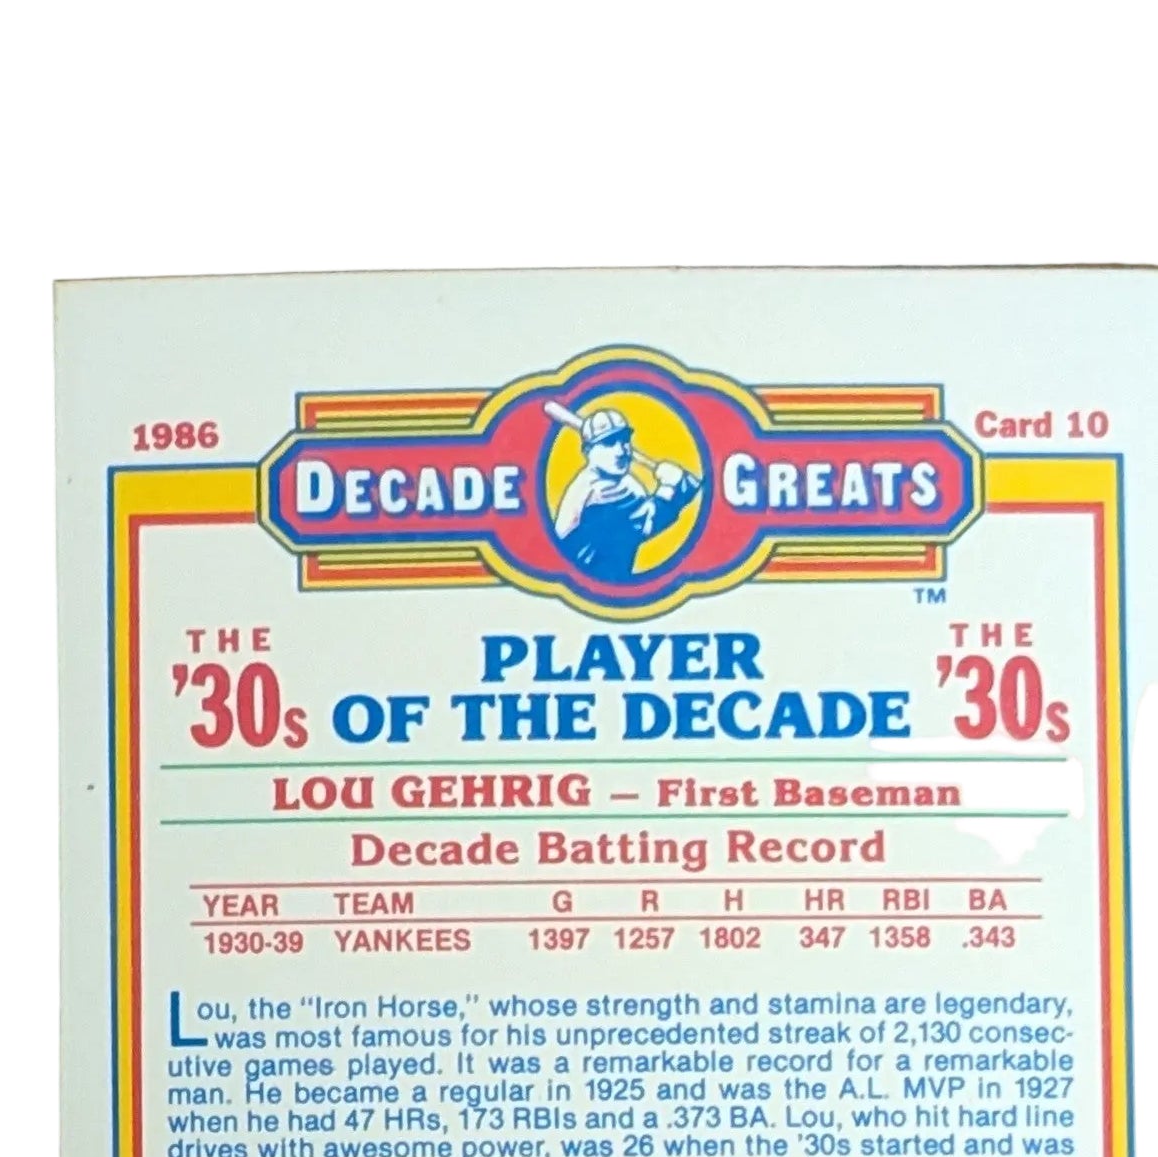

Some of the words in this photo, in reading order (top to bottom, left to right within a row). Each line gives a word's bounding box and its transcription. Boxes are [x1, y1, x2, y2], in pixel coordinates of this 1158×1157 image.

[133, 421, 219, 451] 1986
[975, 410, 1052, 438] Card
[1067, 411, 1110, 438] 10
[296, 458, 523, 515] DECADE
[722, 452, 938, 508] GREATS
[913, 588, 946, 603] TM
[186, 627, 271, 652] THE
[949, 622, 1033, 647] THE
[481, 632, 764, 682] PLAYER
[332, 694, 430, 743] OF
[451, 692, 596, 741] THE
[622, 690, 911, 739] DECADE
[272, 776, 374, 810] LOU
[391, 773, 590, 807] GEHRIG
[657, 778, 759, 807] First
[774, 777, 961, 807] Baseman
[351, 832, 519, 867] Decade
[538, 831, 707, 872] Batting
[727, 830, 885, 864] Record
[203, 894, 279, 917] YEAR
[334, 892, 414, 915] TEAM
[552, 890, 573, 913] G
[641, 890, 660, 912] R
[724, 889, 743, 911] H
[805, 889, 845, 911] HR
[882, 889, 930, 911] RBI
[969, 889, 1008, 911] BA
[204, 930, 304, 955] 1930-39
[334, 929, 472, 953] YANKEES
[528, 928, 589, 951] 1397
[614, 927, 675, 949] 1257
[699, 926, 761, 949] 1802
[799, 926, 846, 949] 347
[869, 926, 931, 949] 1358
[961, 926, 1016, 949] .343
[247, 997, 292, 1019] the
[488, 995, 579, 1017] whose
[585, 994, 701, 1023] strength
[708, 994, 759, 1016] and
[767, 993, 877, 1015] stamina
[883, 997, 927, 1015] are
[935, 991, 1074, 1020] legendary,
[168, 1110, 239, 1133] when
[246, 1110, 280, 1132] he
[287, 1110, 337, 1132] had
[343, 1109, 376, 1131] 47
[383, 1109, 450, 1135] HRs,
[457, 1108, 506, 1131] 173
[512, 1108, 578, 1130] RBIs
[584, 1108, 635, 1130] and
[641, 1112, 659, 1129] a
[666, 1107, 722, 1129] .373
[729, 1107, 777, 1129] BA.
[785, 1106, 843, 1133] Lou,
[850, 1106, 908, 1128] who
[915, 1105, 951, 1128] hit
[958, 1105, 1019, 1127] hard
[1025, 1105, 1075, 1127] line
